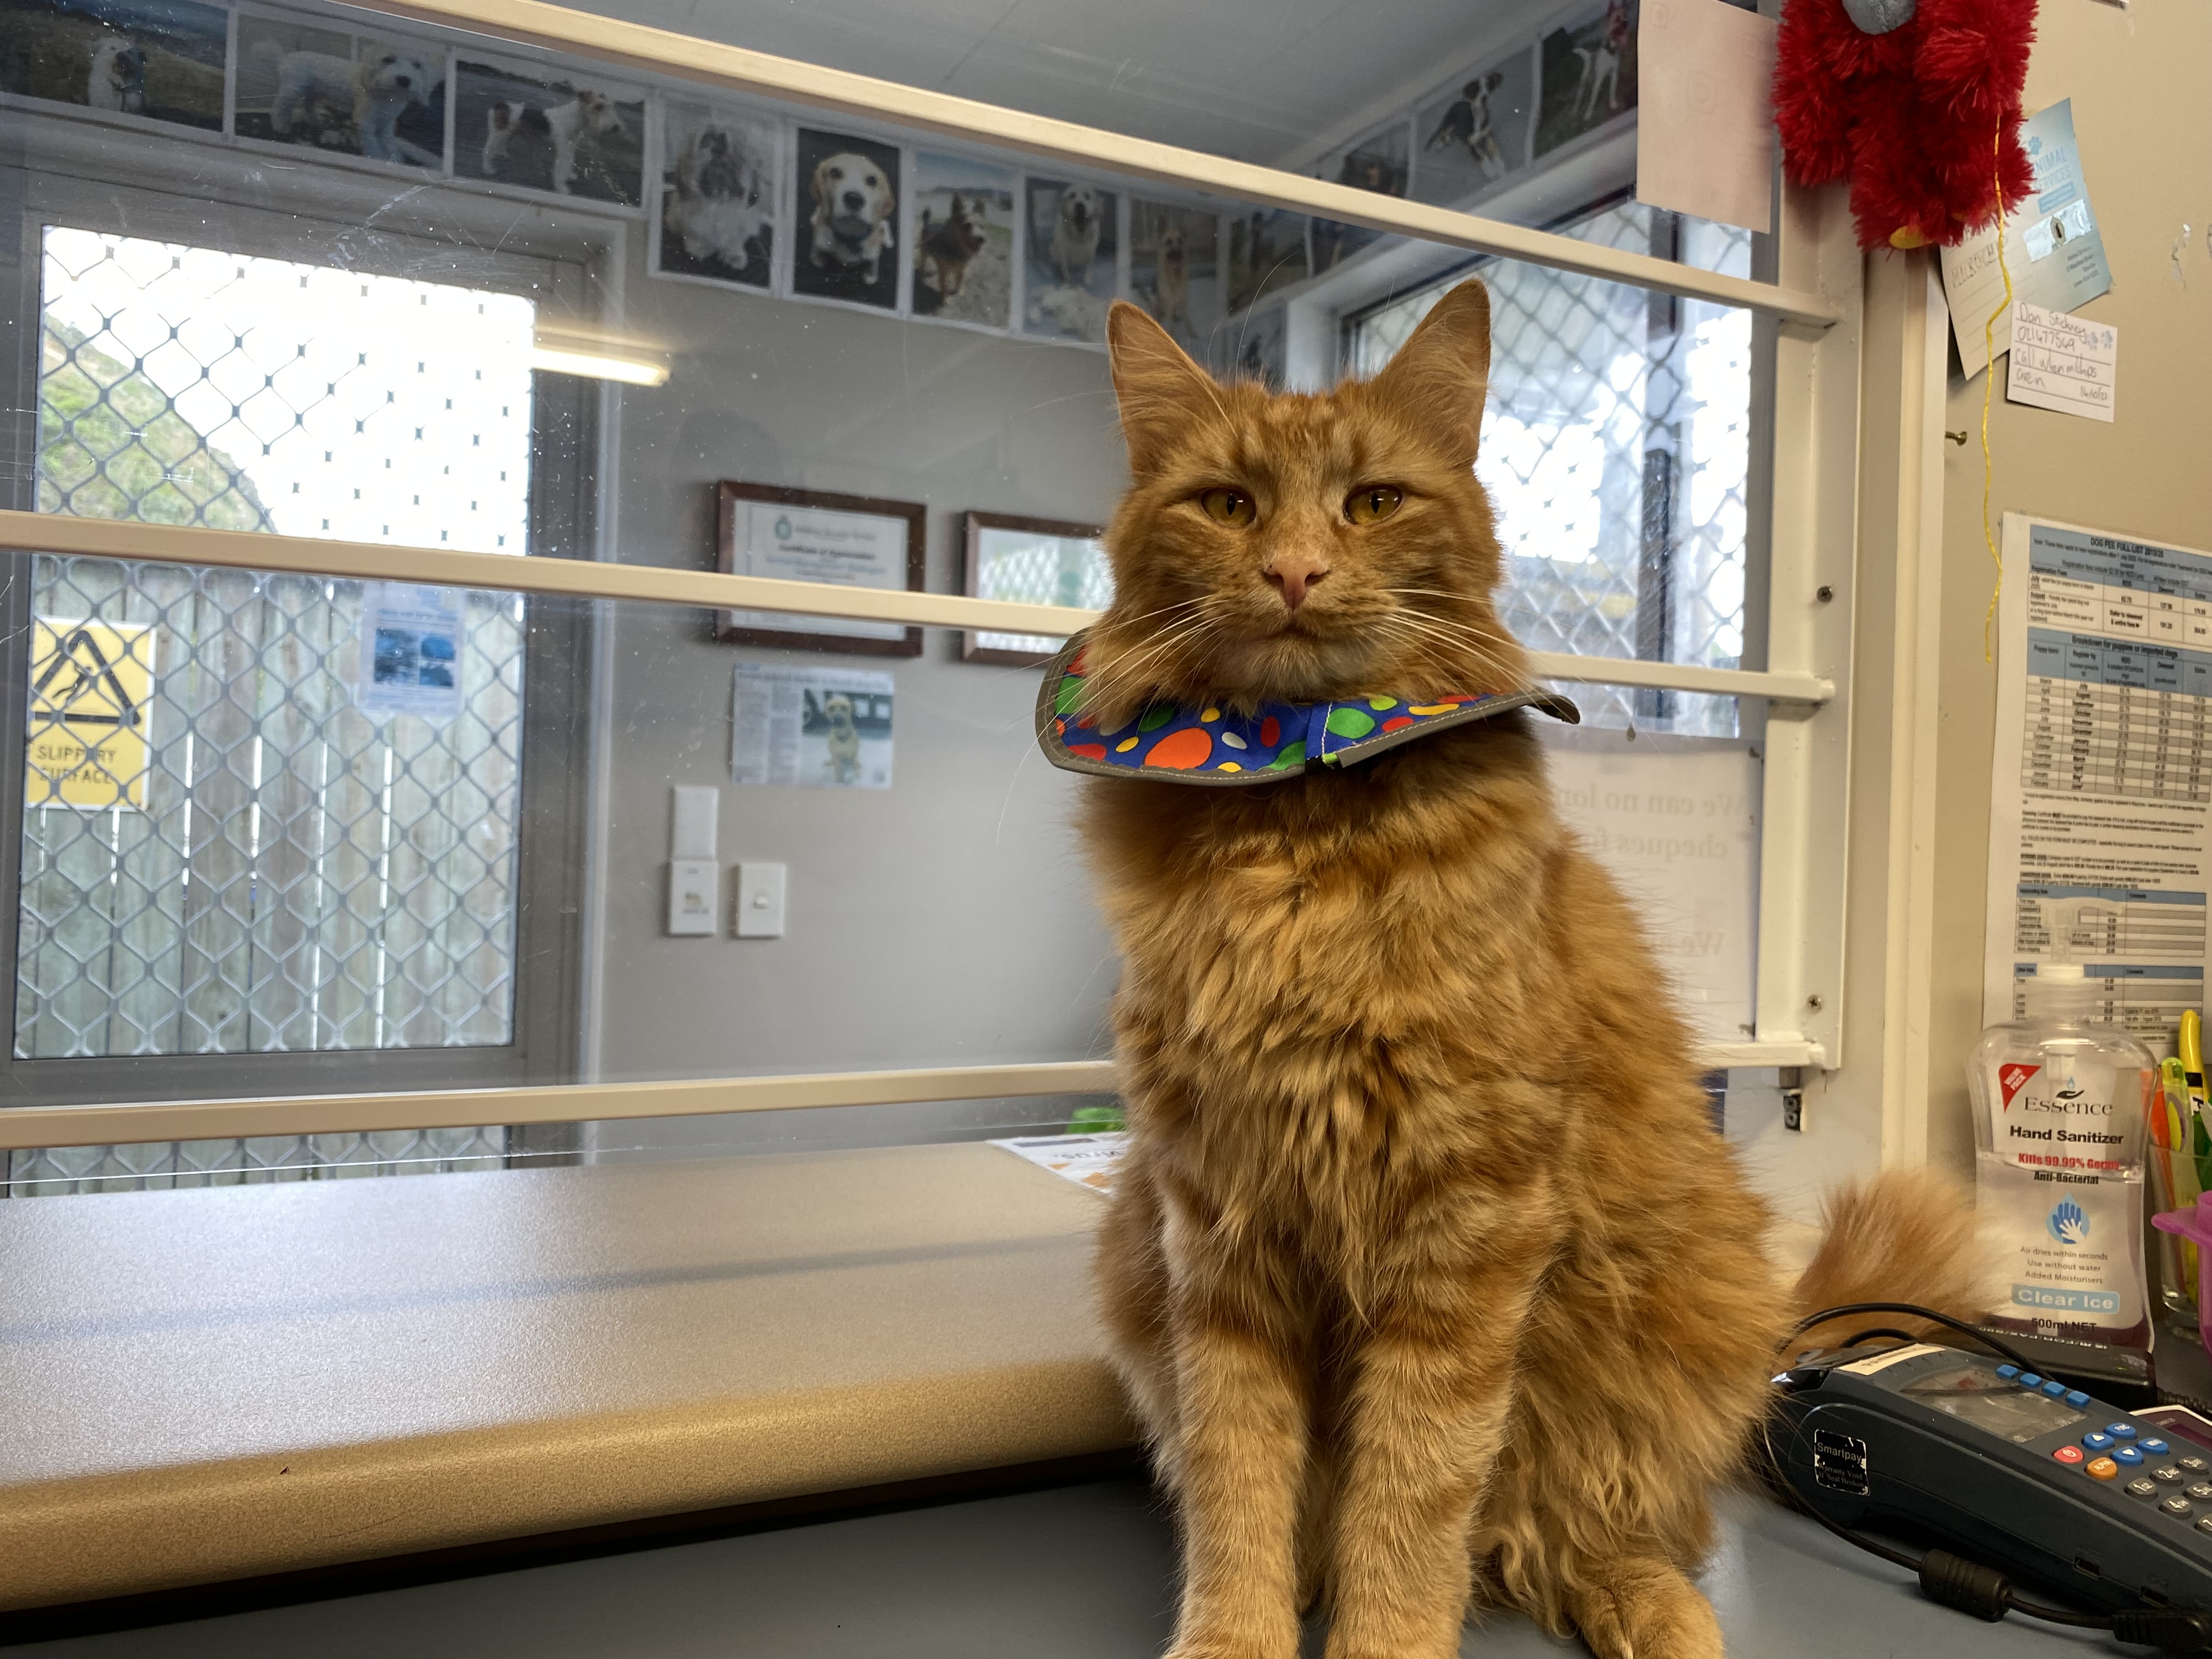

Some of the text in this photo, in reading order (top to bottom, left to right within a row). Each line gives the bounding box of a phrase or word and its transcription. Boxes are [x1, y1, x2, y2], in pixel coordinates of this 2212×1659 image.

[2091, 537, 2103, 548] DOG
[2072, 635, 2102, 646] Breakdown
[37, 745, 117, 764] SLIPPRY
[2024, 1097, 2113, 1116] Essence
[2010, 1125, 2124, 1144] Hand Sanitizer
[2018, 1153, 2119, 1170] Kills 99.99% Germs
[2034, 1171, 2099, 1185] Anti-Bacterial
[2033, 1248, 2051, 1256] dries
[2053, 1249, 2076, 1258] within
[2028, 1259, 2042, 1267] Use
[2045, 1262, 2076, 1270] without
[2025, 1271, 2103, 1284] Added Moisturisers
[2018, 1290, 2113, 1310] Clear Ice
[2032, 1317, 2097, 1331] 500ml NET
[1817, 1442, 1861, 1464] Smartpay
